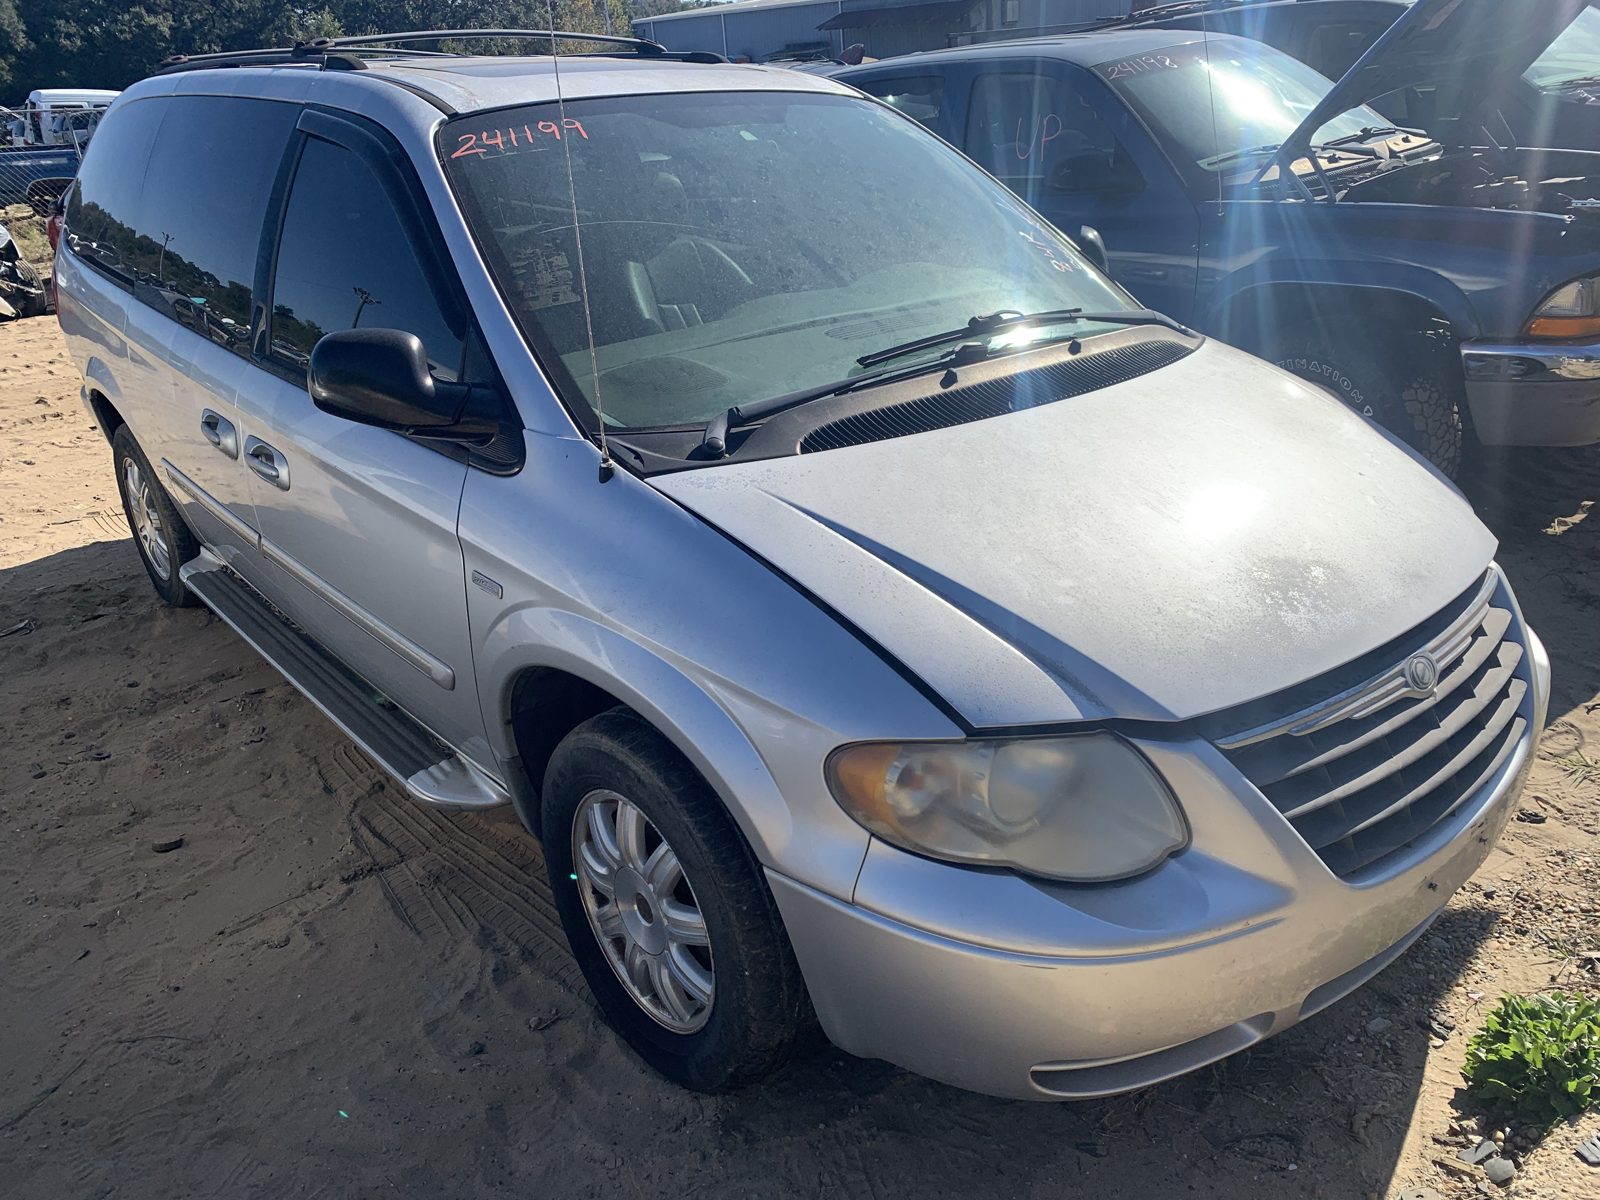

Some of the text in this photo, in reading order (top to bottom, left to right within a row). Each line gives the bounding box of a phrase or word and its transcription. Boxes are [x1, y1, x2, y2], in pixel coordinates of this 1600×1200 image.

[1107, 55, 1178, 80] 241198
[450, 118, 589, 159] 241199
[1015, 113, 1062, 162] UP
